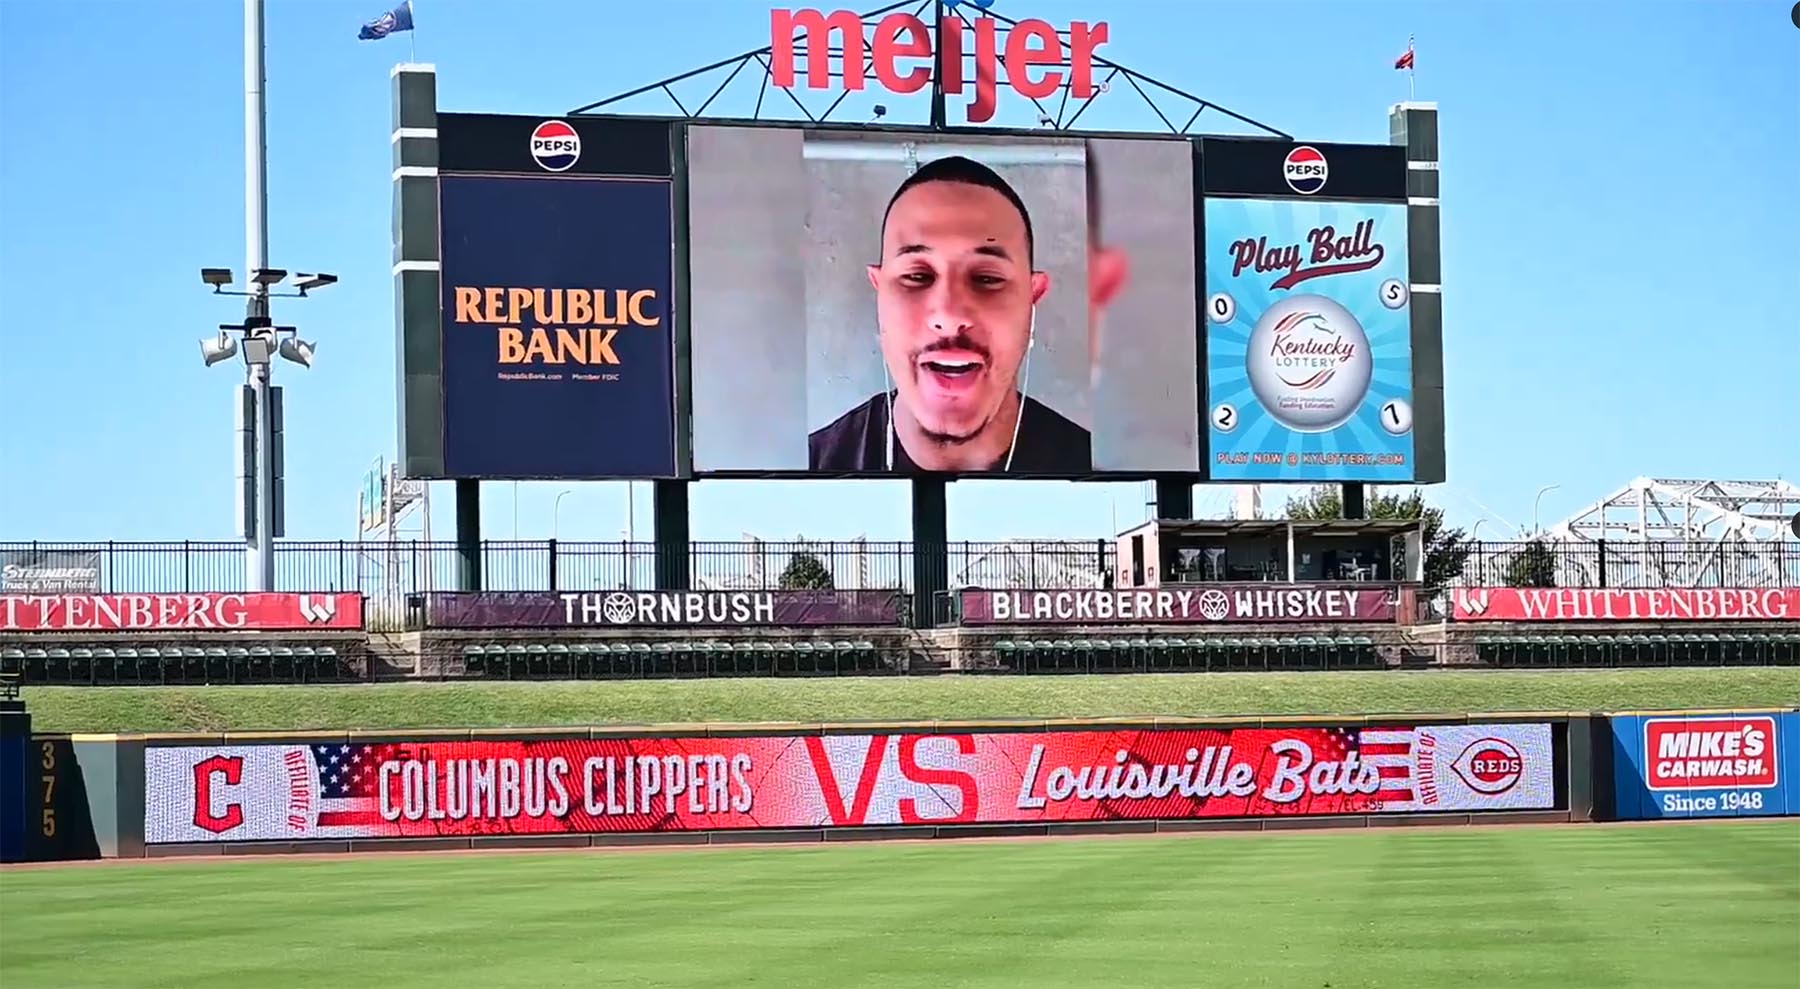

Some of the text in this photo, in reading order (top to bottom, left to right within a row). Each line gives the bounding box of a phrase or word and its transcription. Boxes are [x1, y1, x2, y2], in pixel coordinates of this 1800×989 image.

[770, 0, 1109, 123] meijer
[533, 140, 577, 151] PEPSI
[1286, 164, 1325, 175] PEPSI
[1229, 218, 1378, 278] Play Ball
[455, 286, 660, 326] REPUBLIC
[1215, 297, 1228, 316] 0
[1386, 284, 1400, 300] 5
[498, 327, 621, 364] BANK
[1271, 334, 1355, 362] Kentucky
[1276, 357, 1337, 367] LOTTERY
[1218, 407, 1233, 426] 2
[1217, 452, 1404, 465] PLAY NOW @ KYLOTTERY.COM
[2, 580, 96, 590] Truck & Van Rental
[992, 590, 1360, 620] BLACKBERRY WHISKEY
[1516, 589, 1788, 619] WHITTENBERG
[1658, 724, 1766, 759] MIKE'S
[803, 734, 979, 825] VS
[1016, 738, 1382, 809] Louisville Bats
[1417, 732, 1438, 805] AFFILIATE OF
[1473, 760, 1520, 773] REDS
[193, 755, 243, 833] C
[284, 750, 309, 831] AFFILIATE OF
[379, 752, 754, 821] COLUMBUS CLIPPERS
[1663, 791, 1763, 811] Since 1948
